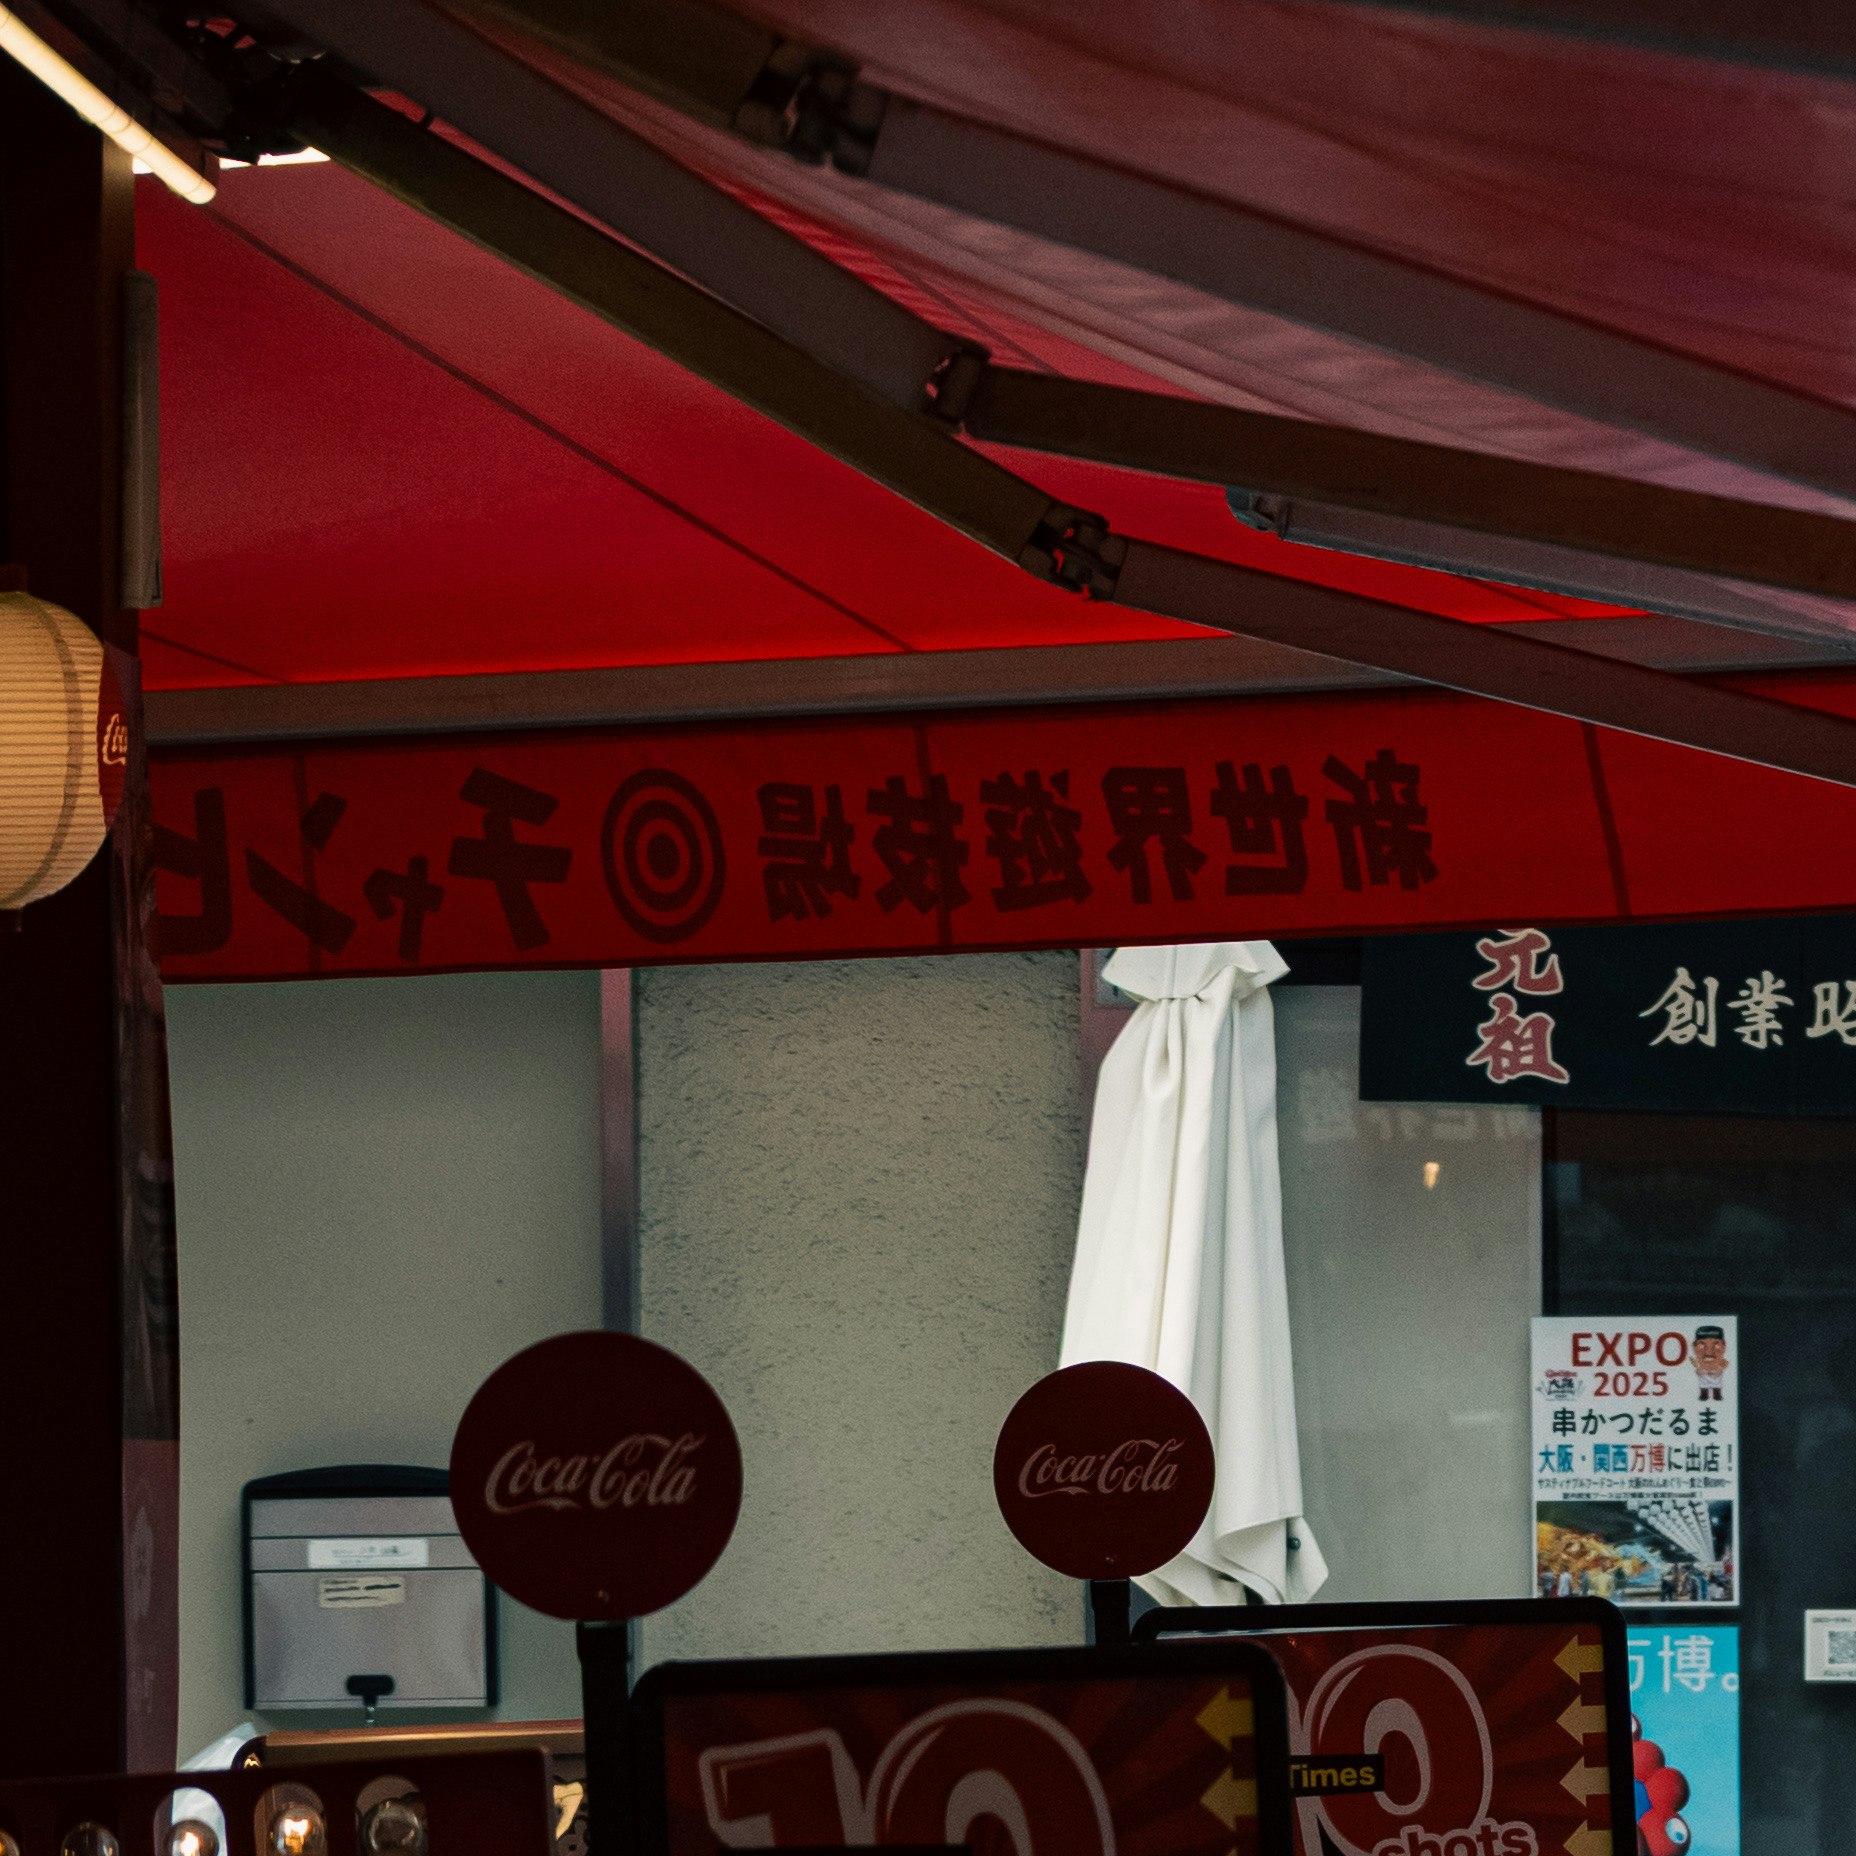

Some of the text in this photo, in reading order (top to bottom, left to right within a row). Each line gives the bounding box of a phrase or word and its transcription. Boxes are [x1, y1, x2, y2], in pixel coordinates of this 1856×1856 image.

[1465, 928, 1571, 1085] 元祖
[1572, 1332, 1688, 1367] EXPO
[1593, 1372, 1669, 1397] 2025
[1552, 1407, 1719, 1438] 串かつだるま
[484, 1433, 707, 1515] Coca-Cola
[1018, 1437, 1188, 1500] Coca-Cola
